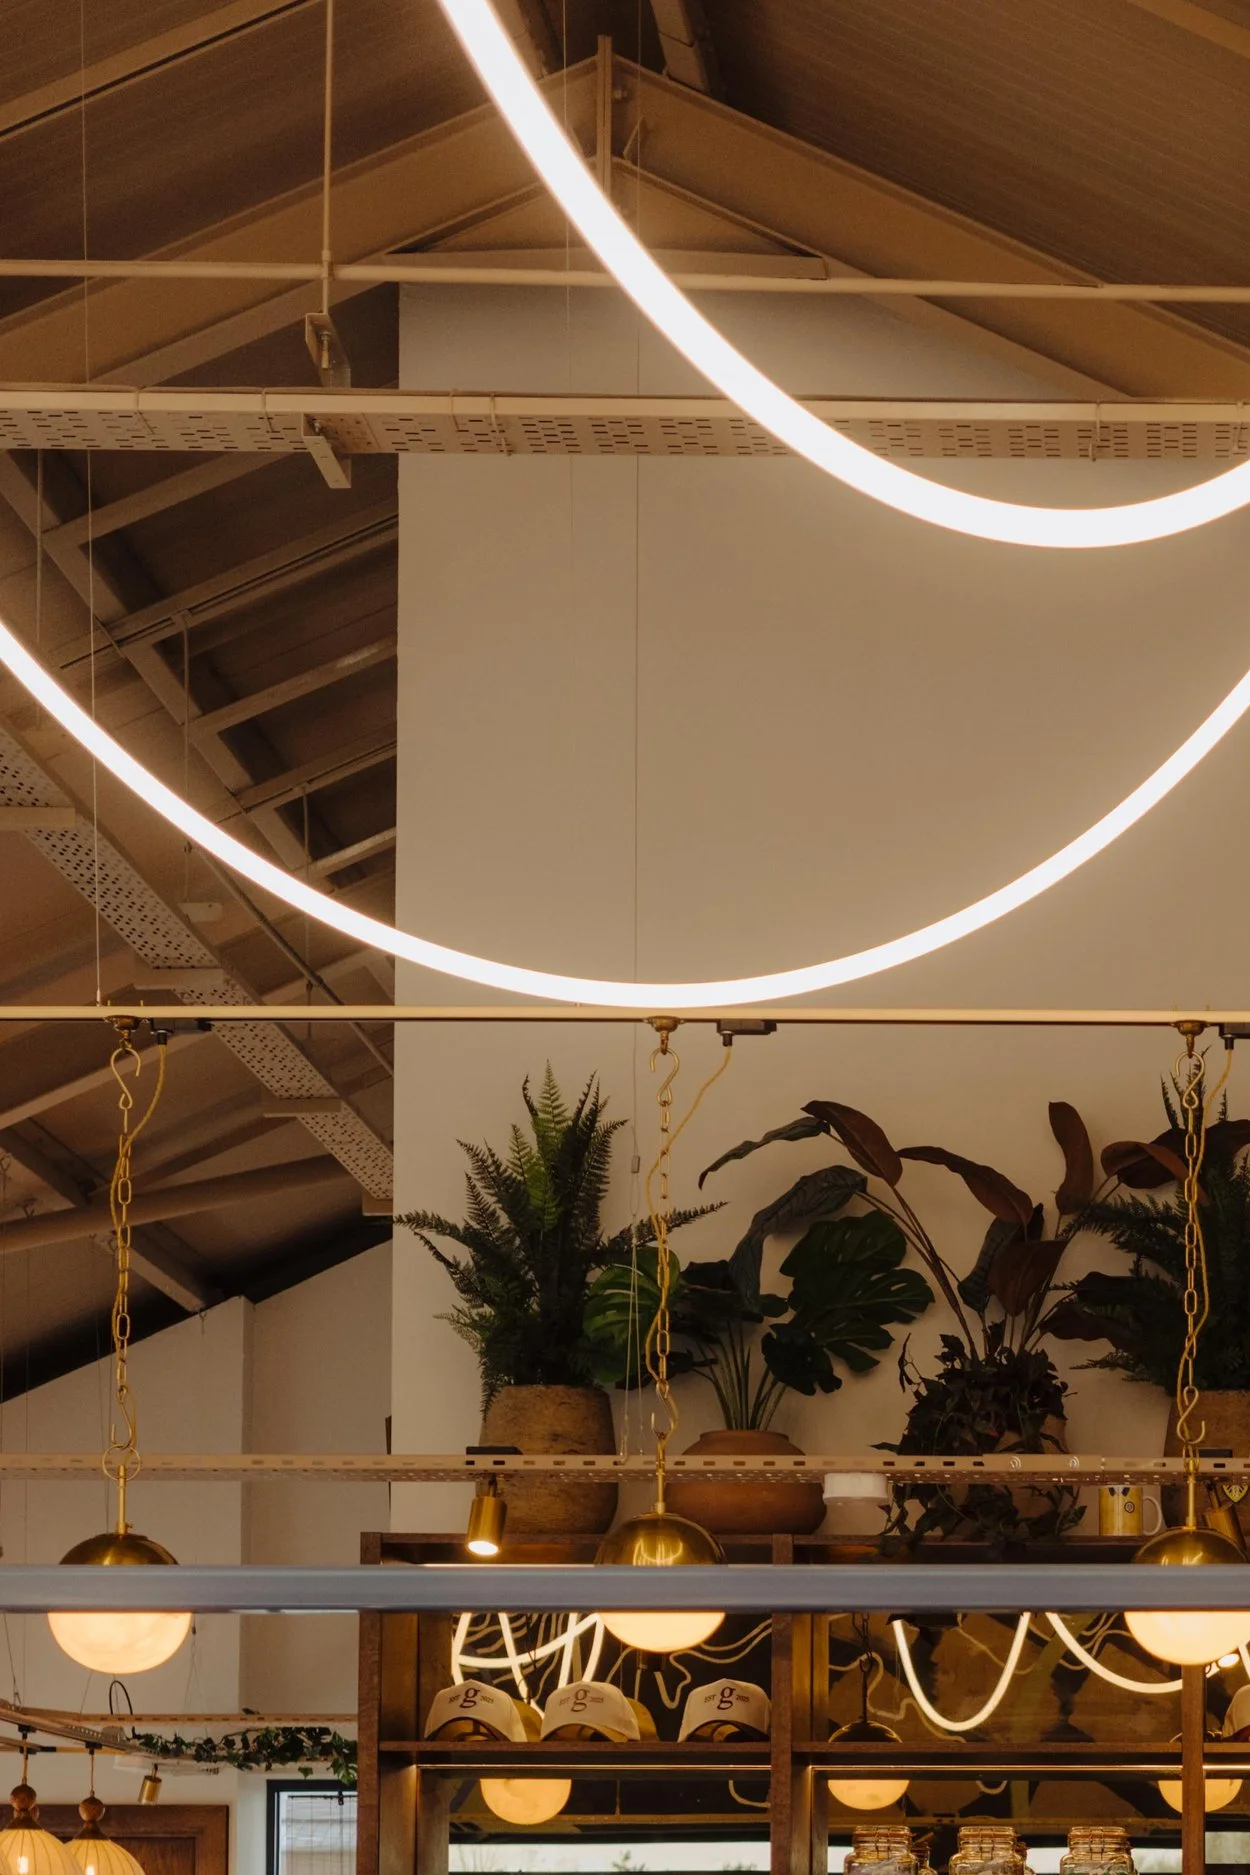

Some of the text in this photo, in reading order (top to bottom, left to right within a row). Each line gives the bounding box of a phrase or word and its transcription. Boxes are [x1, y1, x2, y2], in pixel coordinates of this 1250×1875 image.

[459, 1687, 480, 1708] g
[570, 1688, 590, 1712] g
[717, 1686, 736, 1710] g
